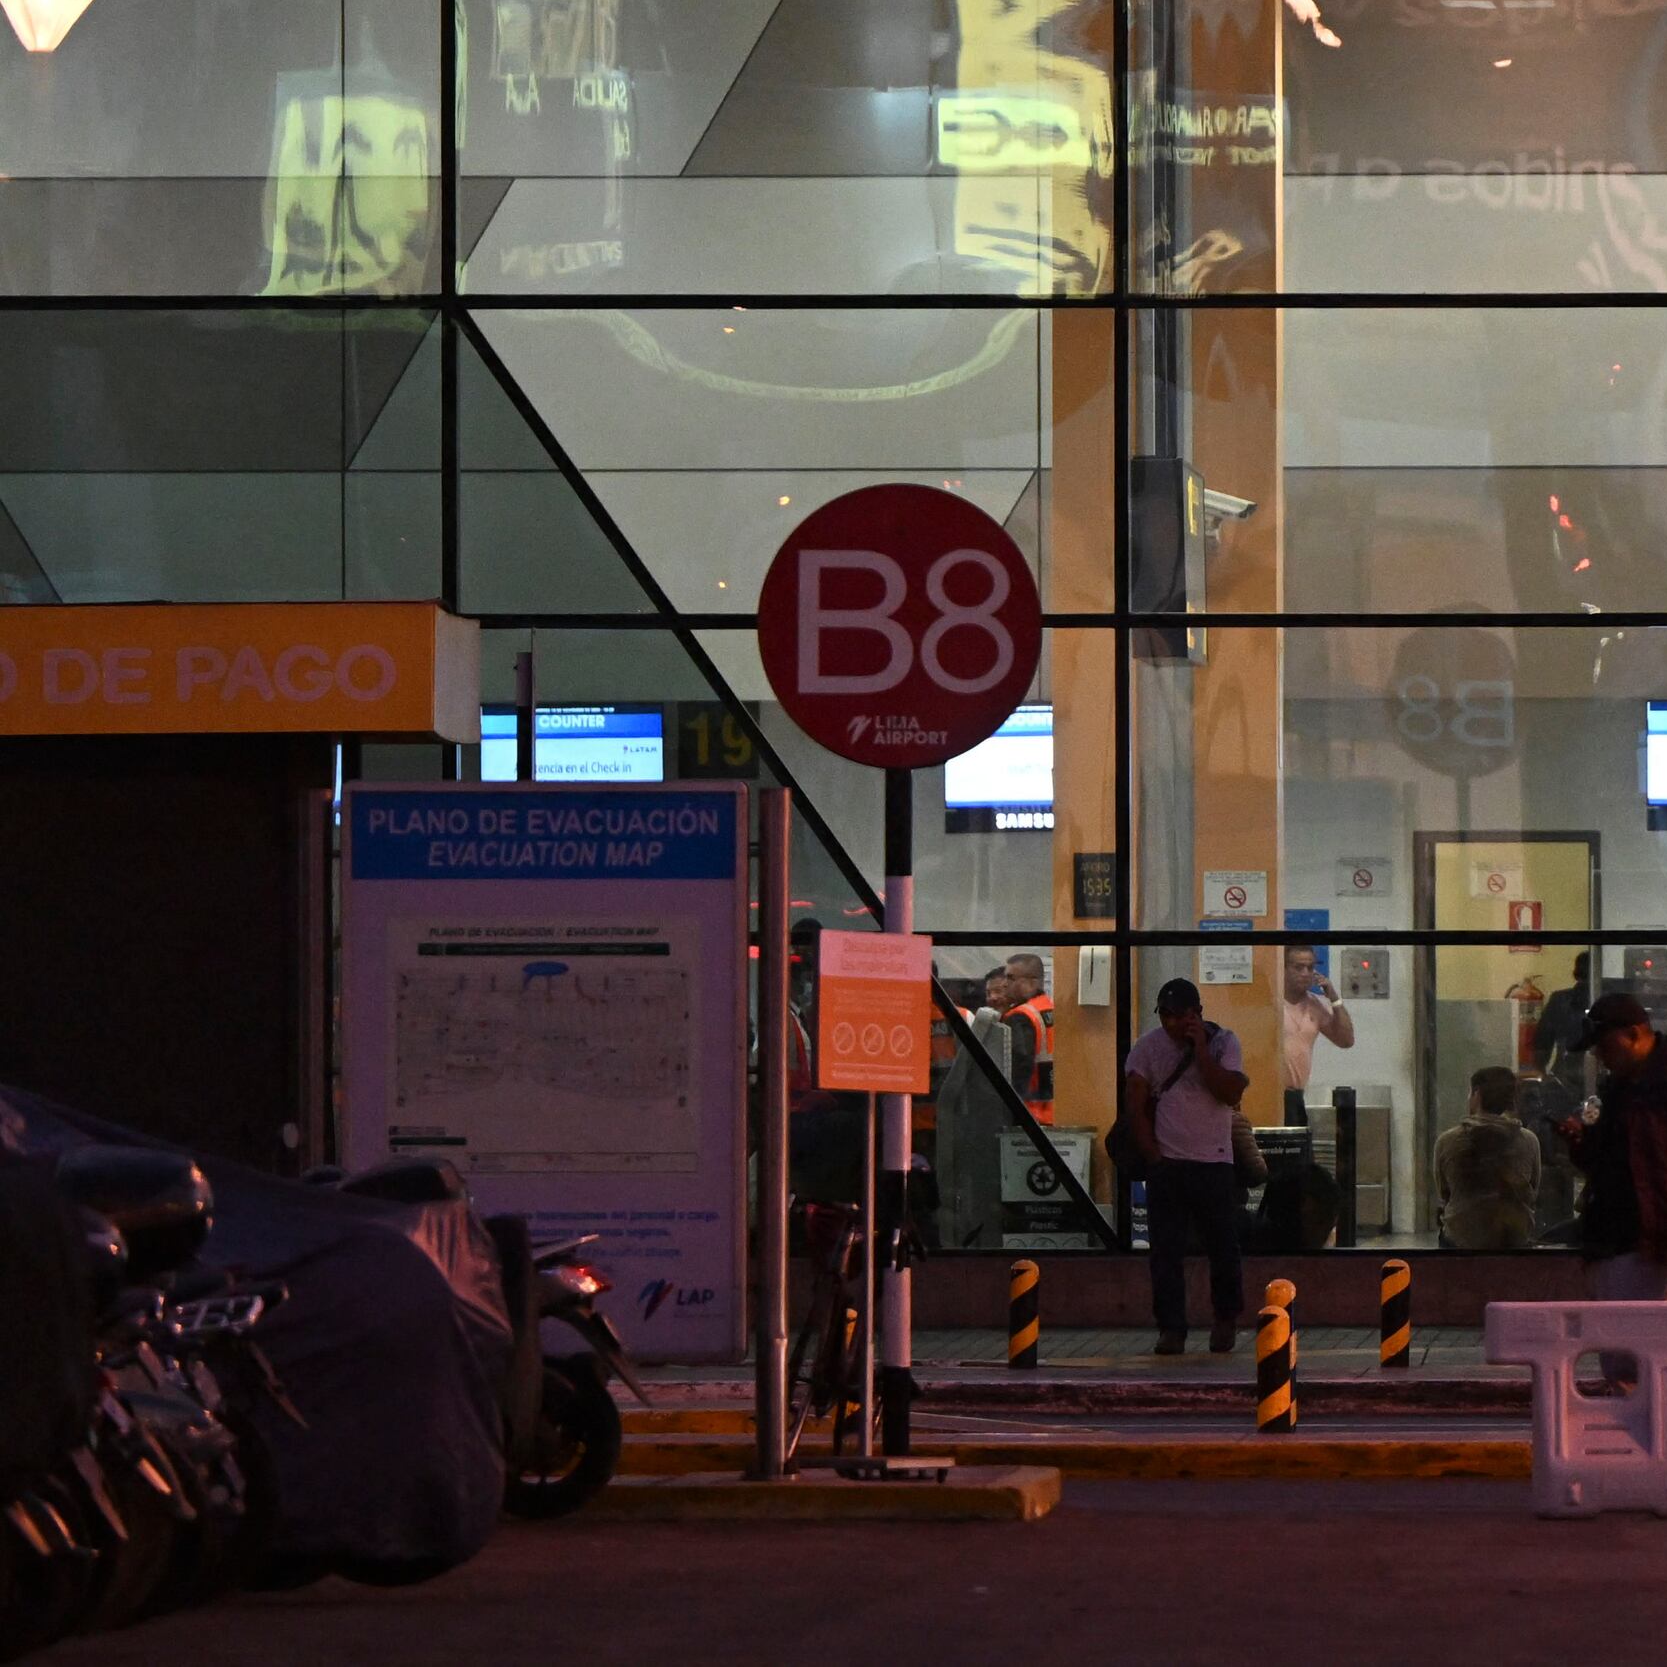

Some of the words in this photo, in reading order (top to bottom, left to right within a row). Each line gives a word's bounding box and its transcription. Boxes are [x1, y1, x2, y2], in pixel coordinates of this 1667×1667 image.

[798, 549, 1015, 694] B8
[43, 647, 153, 704] DE
[176, 644, 398, 702] PAGO
[539, 715, 605, 728] COUNTER
[874, 717, 920, 731] LIMA
[689, 709, 751, 767] 19
[873, 731, 948, 745] AIRPORT
[566, 764, 578, 773] en
[580, 762, 589, 773] el
[591, 761, 619, 774] Check
[622, 762, 632, 773] in
[367, 809, 470, 835] PLANO
[478, 809, 518, 835] DE
[526, 803, 719, 835] EVACUACIÓN
[996, 814, 1054, 829] SAMSU
[428, 841, 597, 867] EVACUATION
[604, 841, 664, 867] MAP
[676, 1288, 715, 1306] LAP
